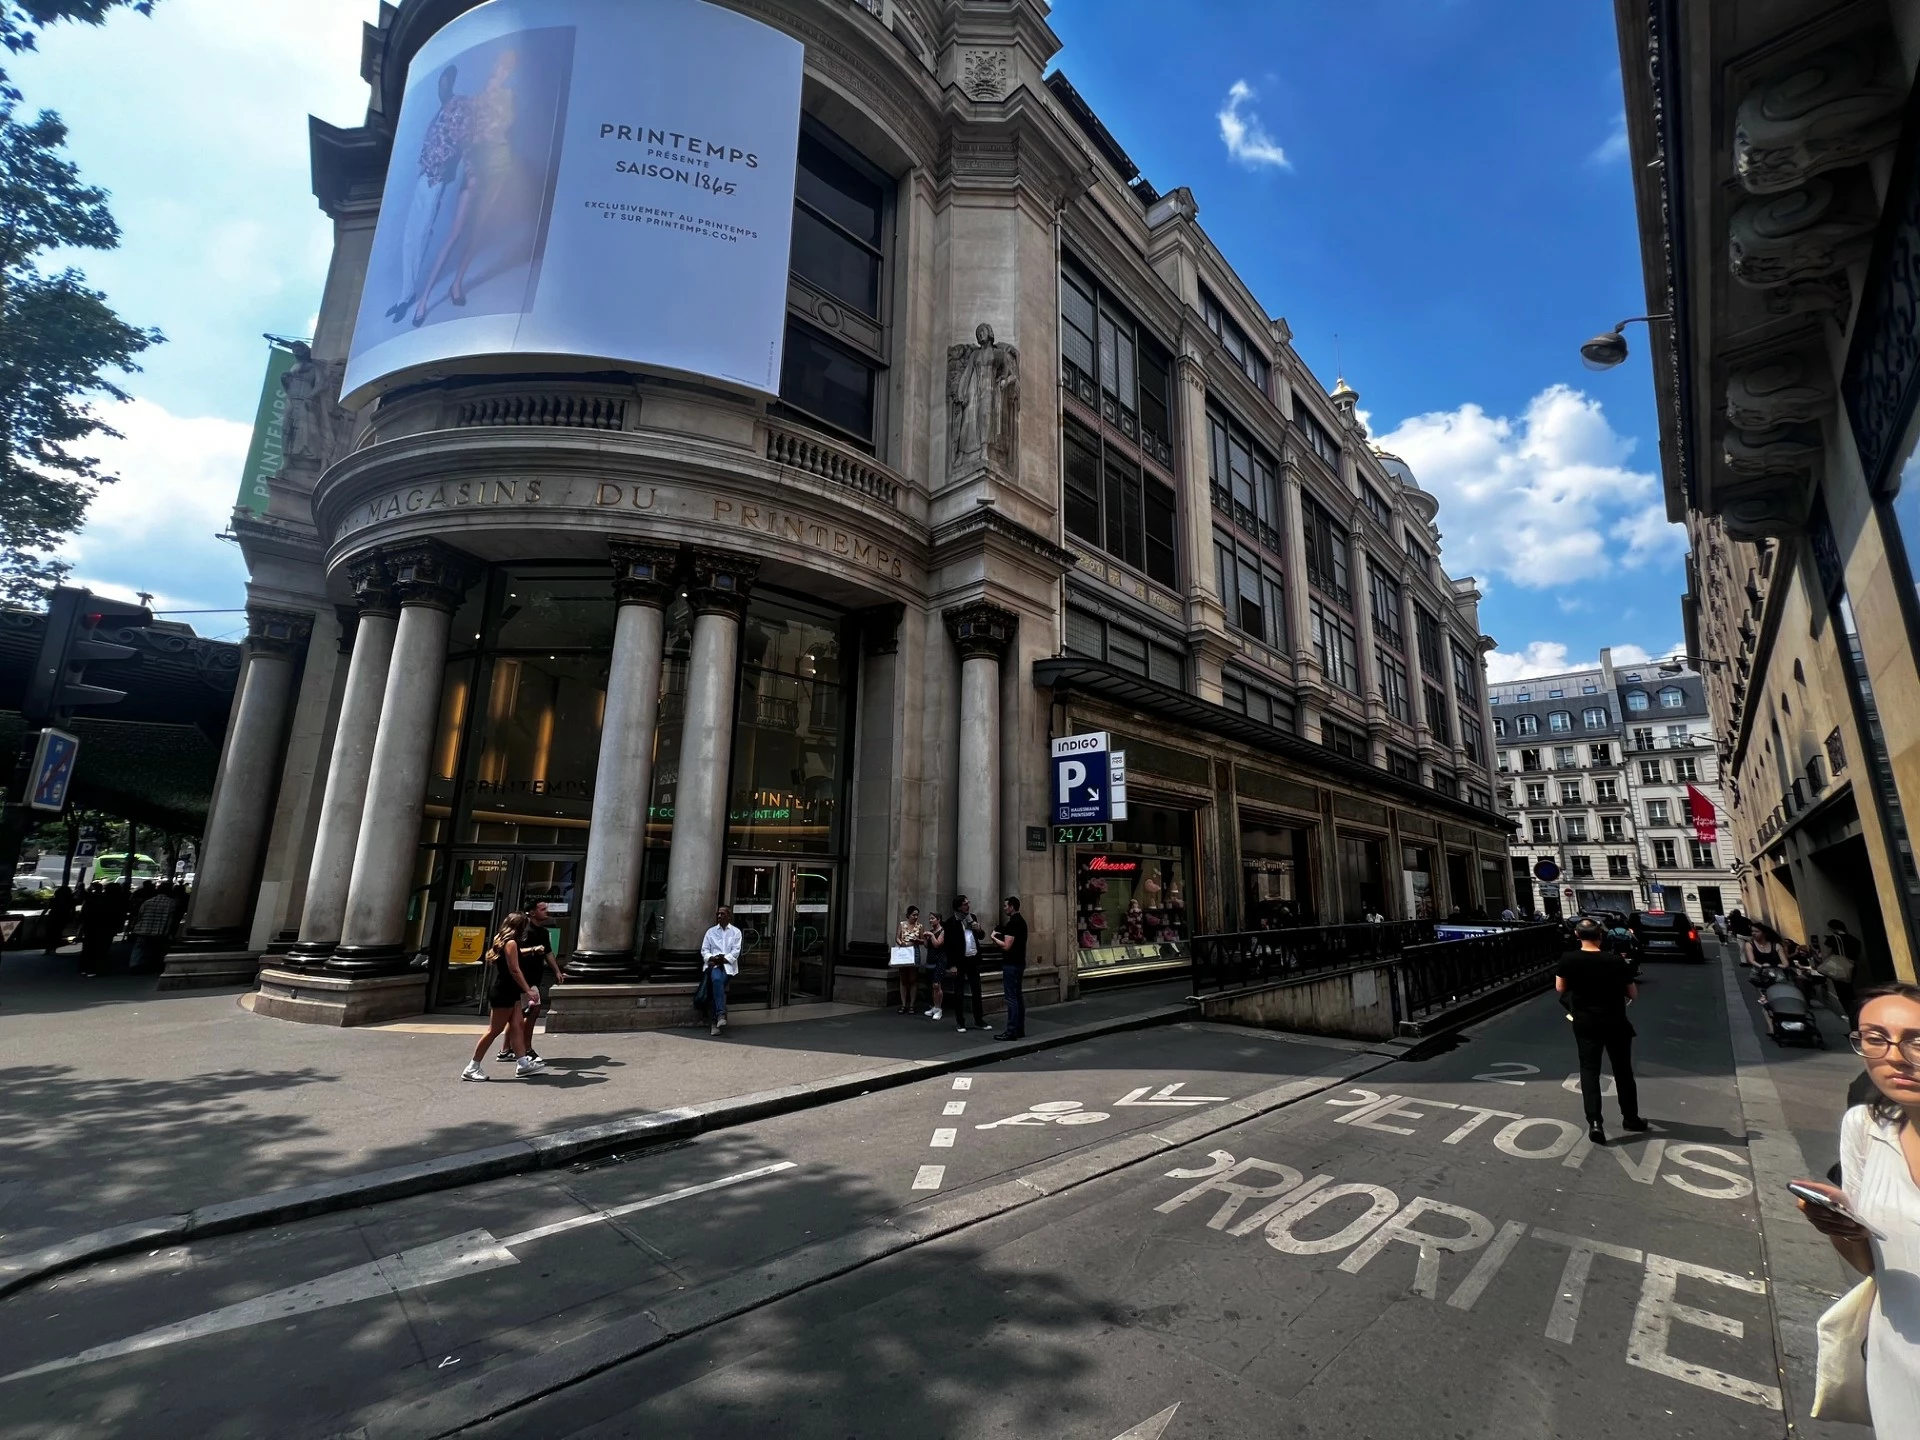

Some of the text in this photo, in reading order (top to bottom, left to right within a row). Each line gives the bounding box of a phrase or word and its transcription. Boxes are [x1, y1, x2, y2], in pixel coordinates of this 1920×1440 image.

[600, 123, 759, 168] PRINTEMPS
[647, 148, 710, 168] PRÉSENTE
[616, 160, 738, 196] SAISON 1865
[584, 201, 759, 239] EXCLUSIVEMENT AU PRINTEMPS
[603, 211, 738, 243] ET SUR PRINTEMPS.COM
[366, 480, 904, 579] MAGASINS DU PRINTEMPS
[1058, 737, 1099, 752] INDIGO
[1059, 760, 1087, 804] P
[1058, 828, 1074, 843] 24
[1087, 826, 1104, 842] 24
